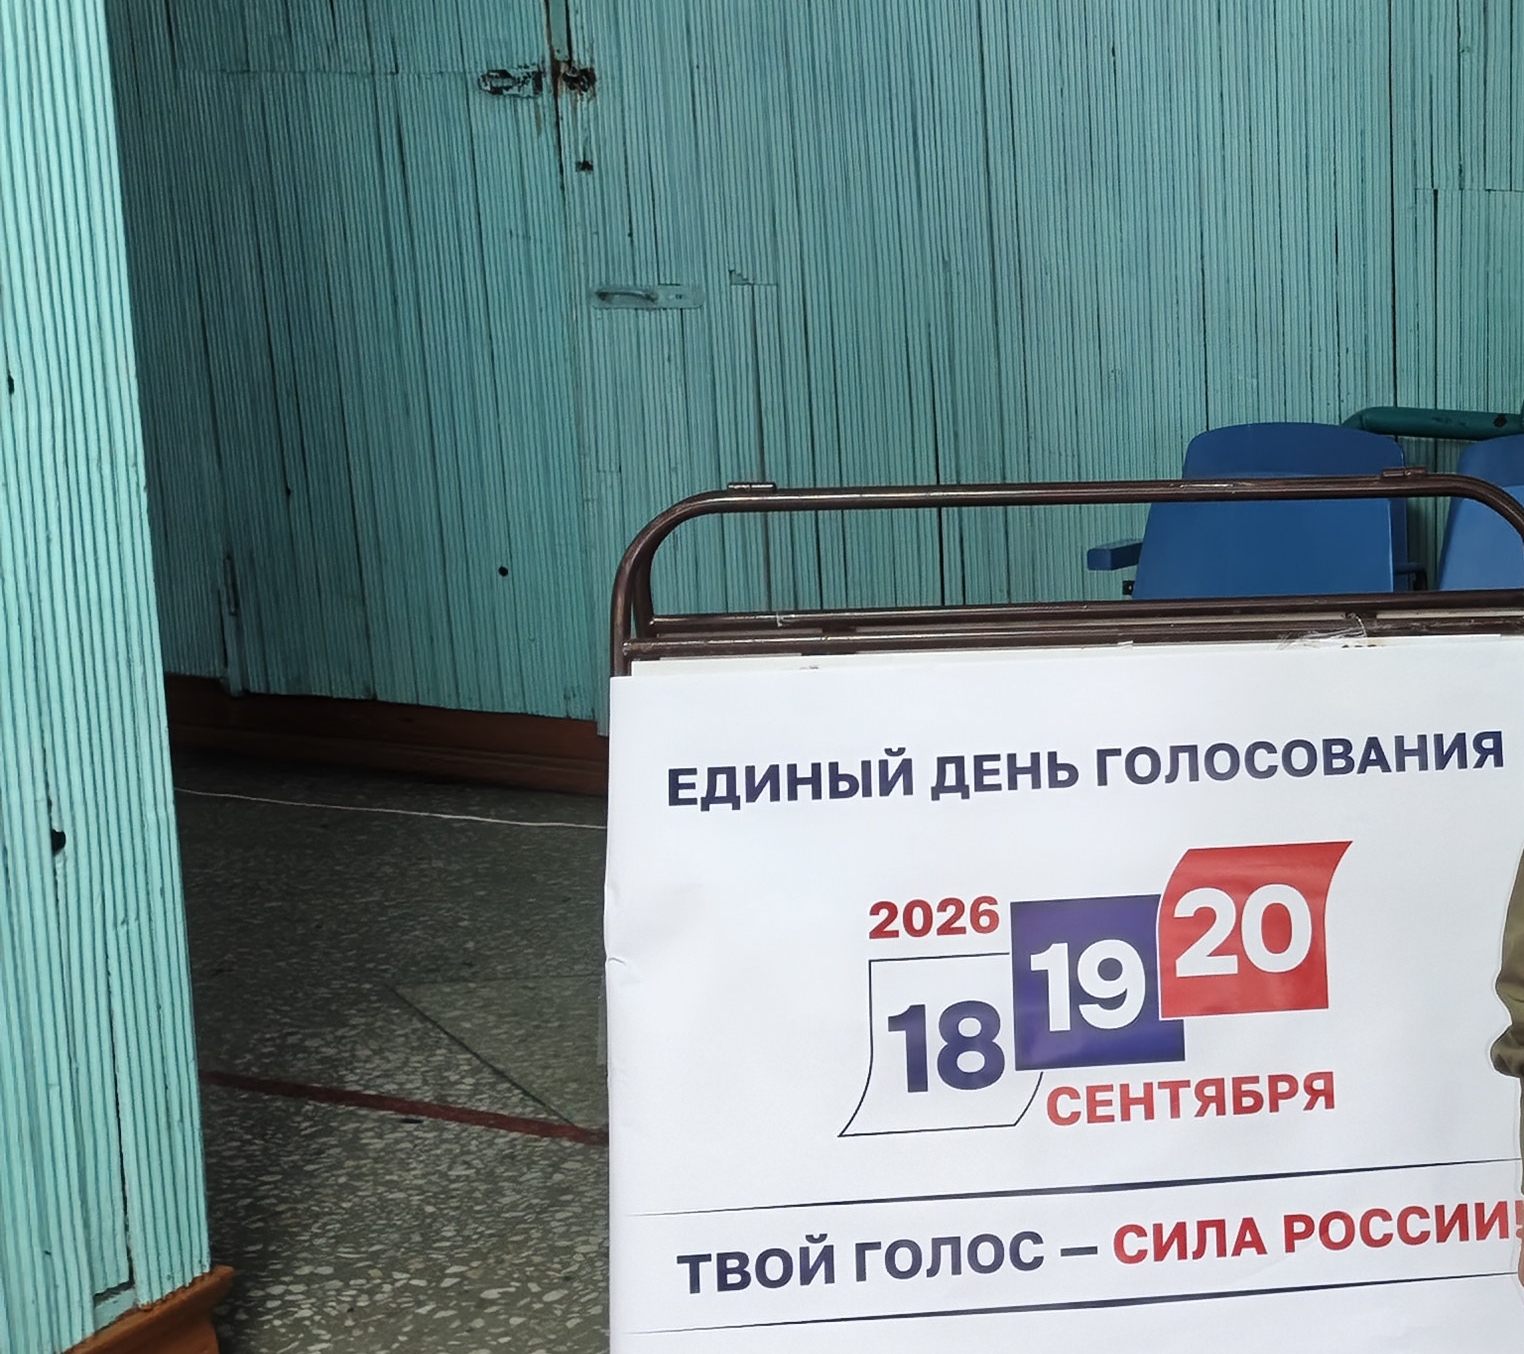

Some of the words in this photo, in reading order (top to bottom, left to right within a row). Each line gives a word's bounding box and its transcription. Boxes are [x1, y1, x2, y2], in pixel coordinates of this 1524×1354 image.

[668, 747, 914, 812] ЕДИНЫЙ
[930, 751, 1079, 801] ДЕНЬ
[1096, 730, 1504, 787] ГОЛОСОВАНИЯ
[869, 895, 1000, 940] 2026
[887, 1000, 1005, 1093] 18
[1029, 941, 1145, 1033] 19
[1173, 883, 1313, 978] 20
[1045, 1071, 1335, 1126] СЕНТЯБРЯ
[676, 1233, 835, 1295] ТВОЙ
[855, 1231, 1045, 1282] ГОЛОС
[1113, 1217, 1268, 1265] СИЛА
[1283, 1199, 1523, 1254] РОССИИ!
